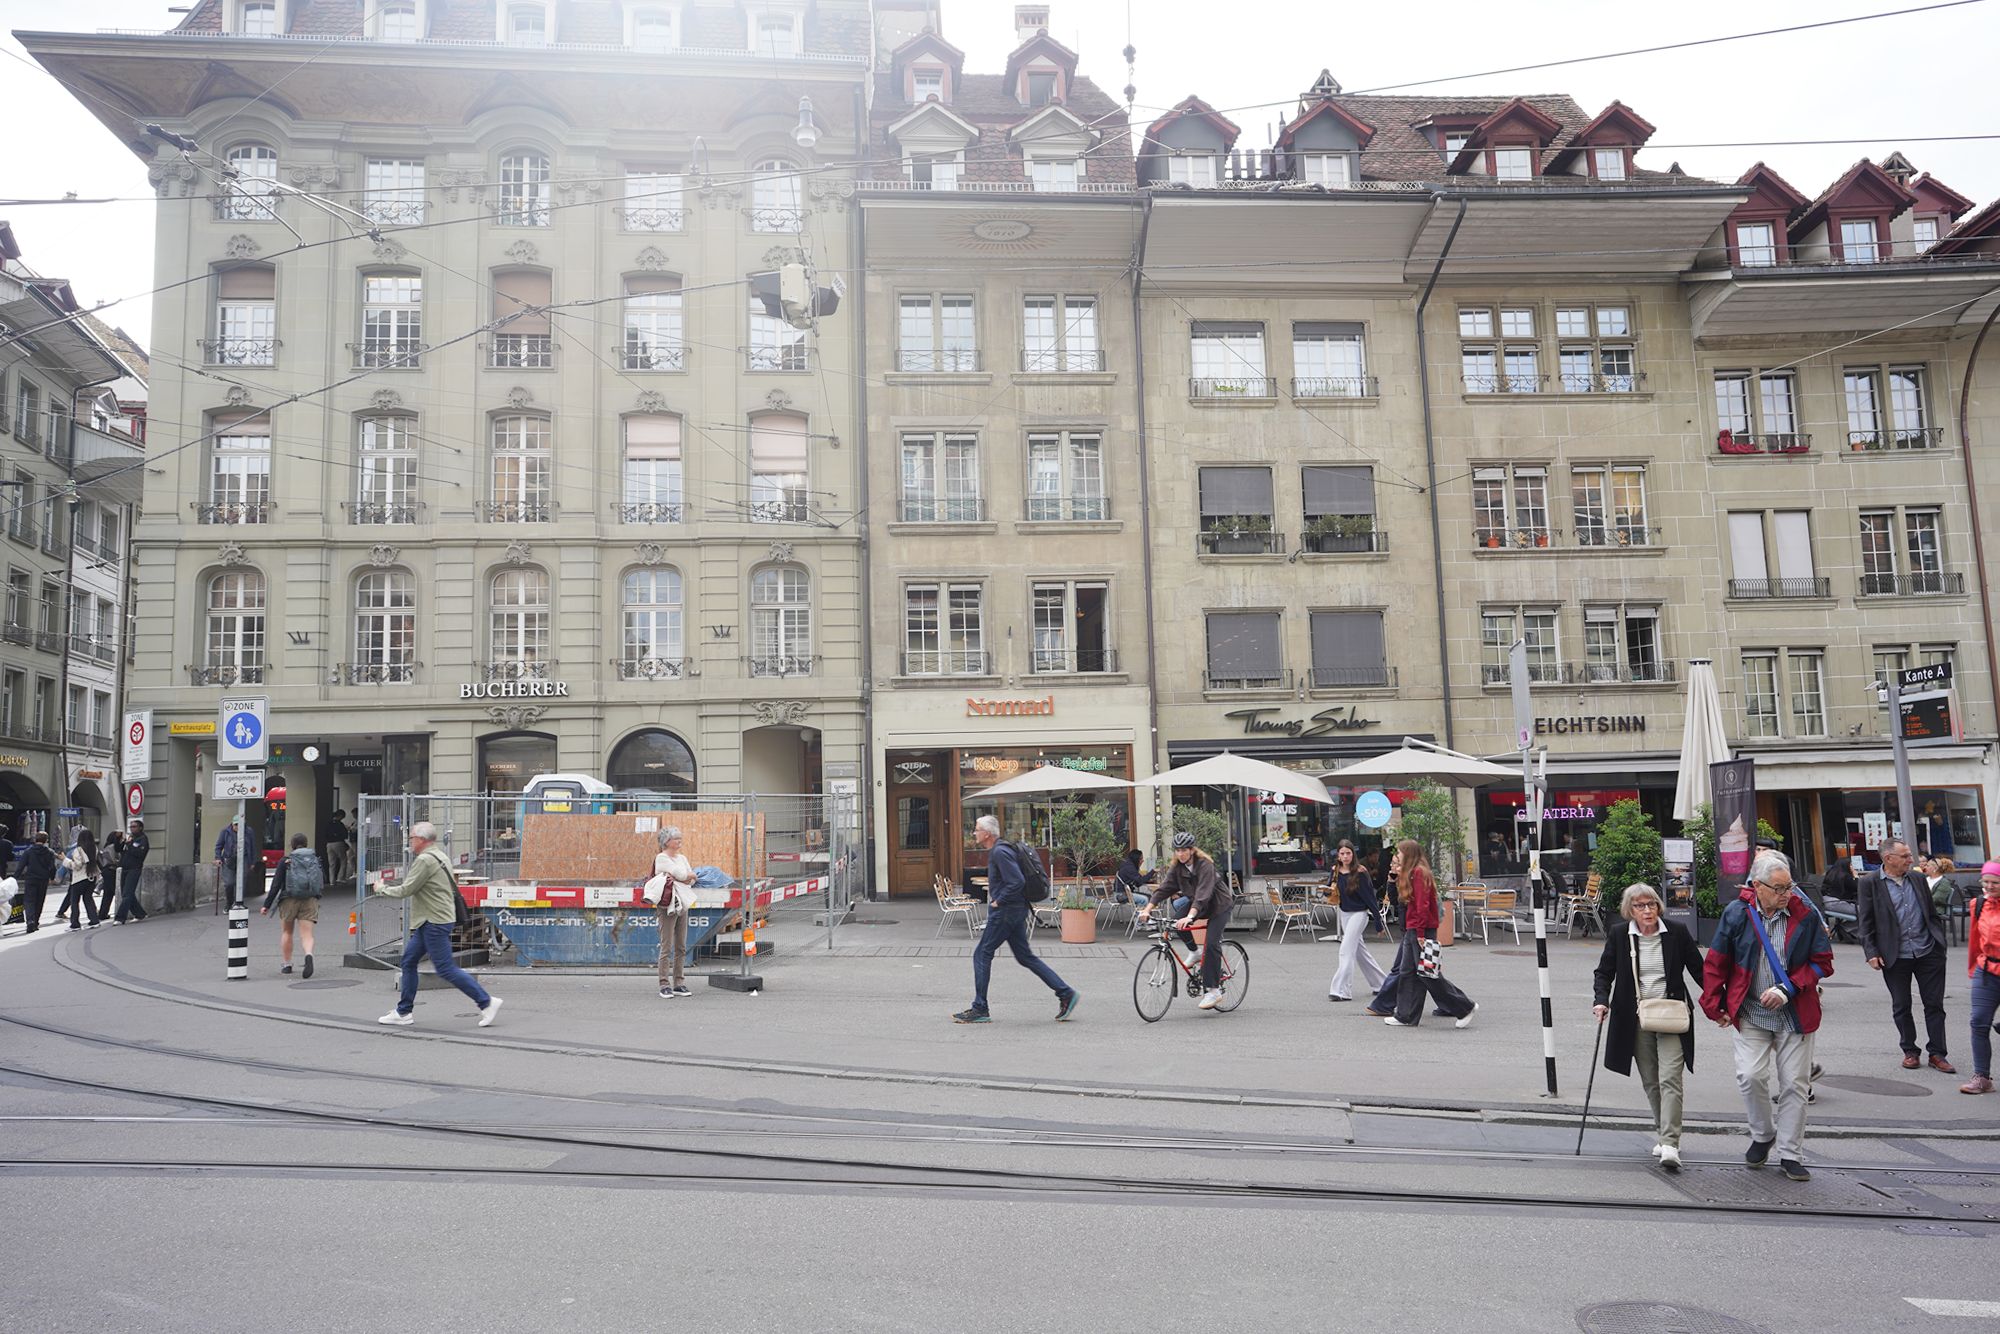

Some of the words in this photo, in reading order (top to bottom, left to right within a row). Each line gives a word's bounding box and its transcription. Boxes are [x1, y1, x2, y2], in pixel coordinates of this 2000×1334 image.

[1905, 669, 1933, 683] Kante
[1937, 665, 1944, 677] A
[459, 681, 569, 699] BUCHERER
[234, 702, 255, 711] ZONE
[966, 695, 1055, 718] Nomad
[130, 713, 144, 722] ZONE
[1224, 707, 1304, 737] Thomas
[1302, 705, 1382, 738] Sabo
[173, 723, 211, 732] Kornhausplatz
[1534, 715, 1646, 734] EICHTSINN
[344, 759, 382, 767] BUCHER
[974, 756, 1019, 773] Kebap
[218, 775, 260, 783] ausgenommen
[1262, 804, 1297, 815] PEANUTS
[1361, 806, 1389, 819] -50%
[1516, 807, 1595, 820] GATERIA
